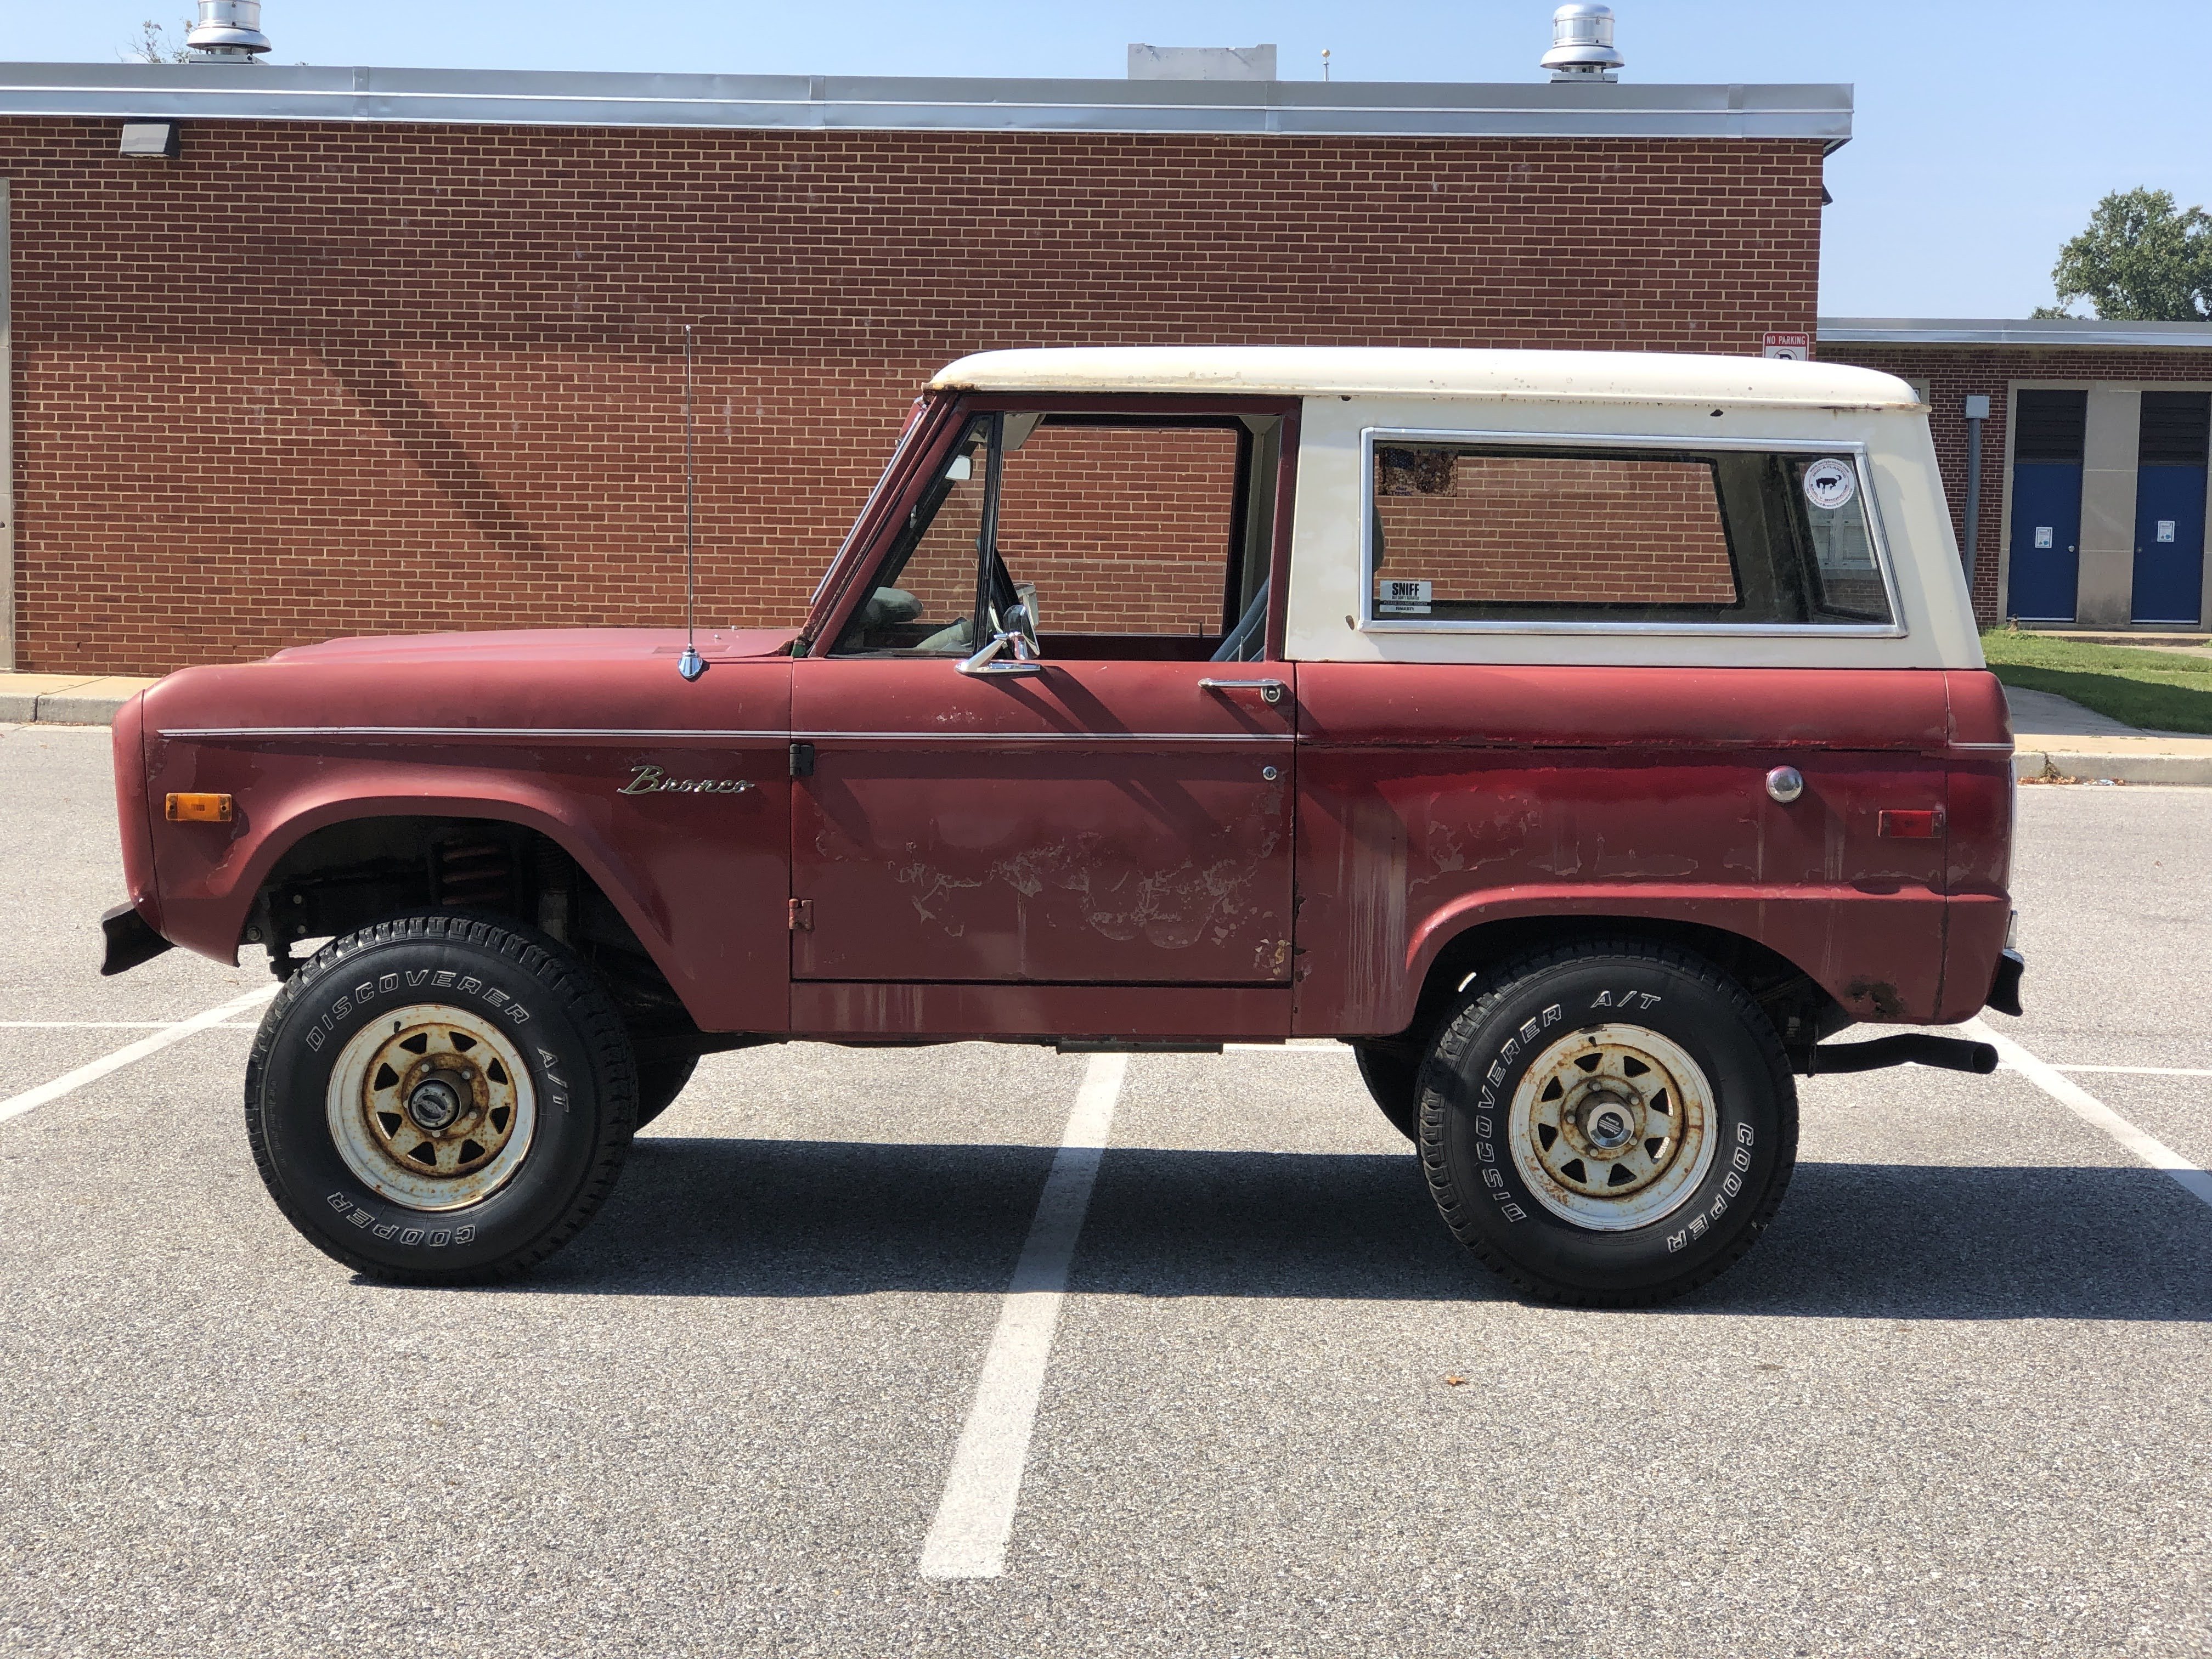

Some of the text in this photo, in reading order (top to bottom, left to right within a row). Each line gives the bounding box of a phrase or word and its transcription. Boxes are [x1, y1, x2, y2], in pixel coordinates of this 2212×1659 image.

[1767, 335, 1805, 345] NO PARKING
[1813, 465, 1847, 478] MID ATLANTIC
[1392, 583, 1420, 596] SNIFF
[616, 765, 755, 794] Bronco
[305, 969, 571, 1114] DISCOVERER A/T
[1475, 990, 1662, 1223] DISCOVERER A/T
[1667, 1121, 1754, 1254] COOPER
[328, 1190, 477, 1247] COOPER
